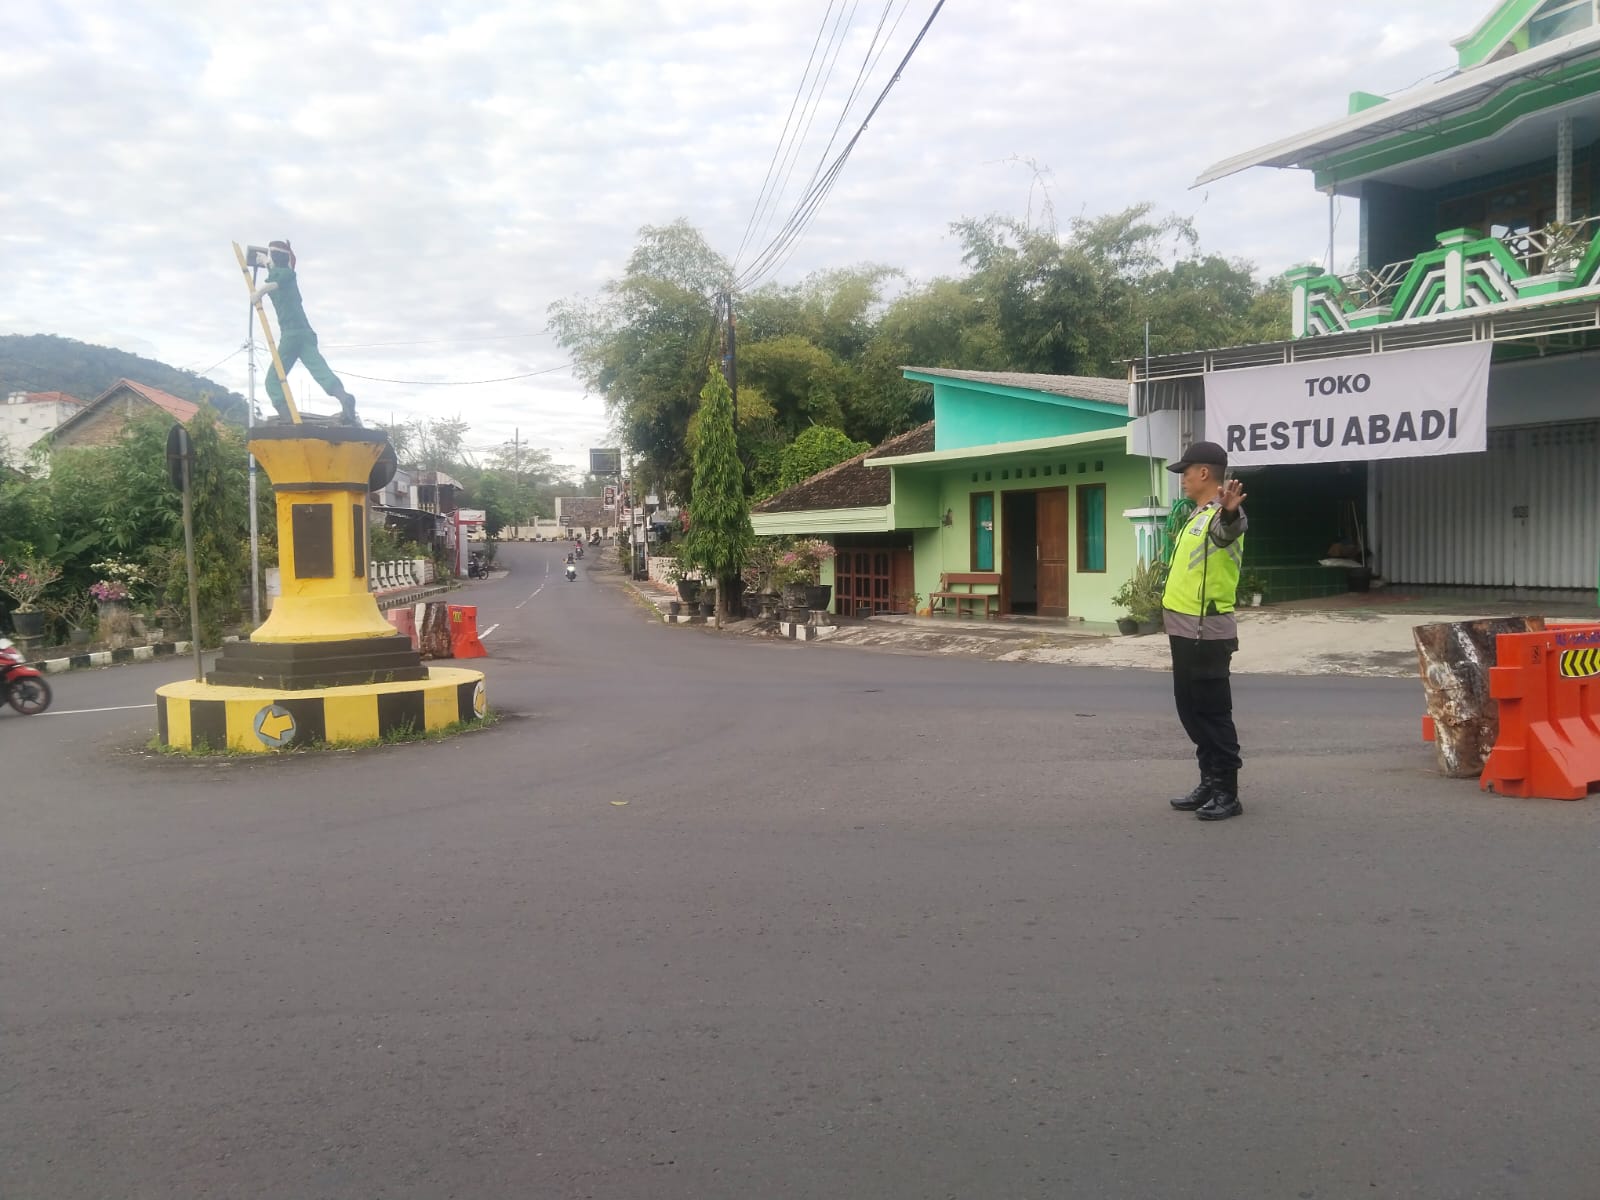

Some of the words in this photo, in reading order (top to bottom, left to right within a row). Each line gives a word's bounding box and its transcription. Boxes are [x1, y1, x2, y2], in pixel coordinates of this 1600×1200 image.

[1305, 373, 1371, 397] TOKO
[1226, 417, 1335, 452] RESTU
[1341, 407, 1459, 446] ABADI
